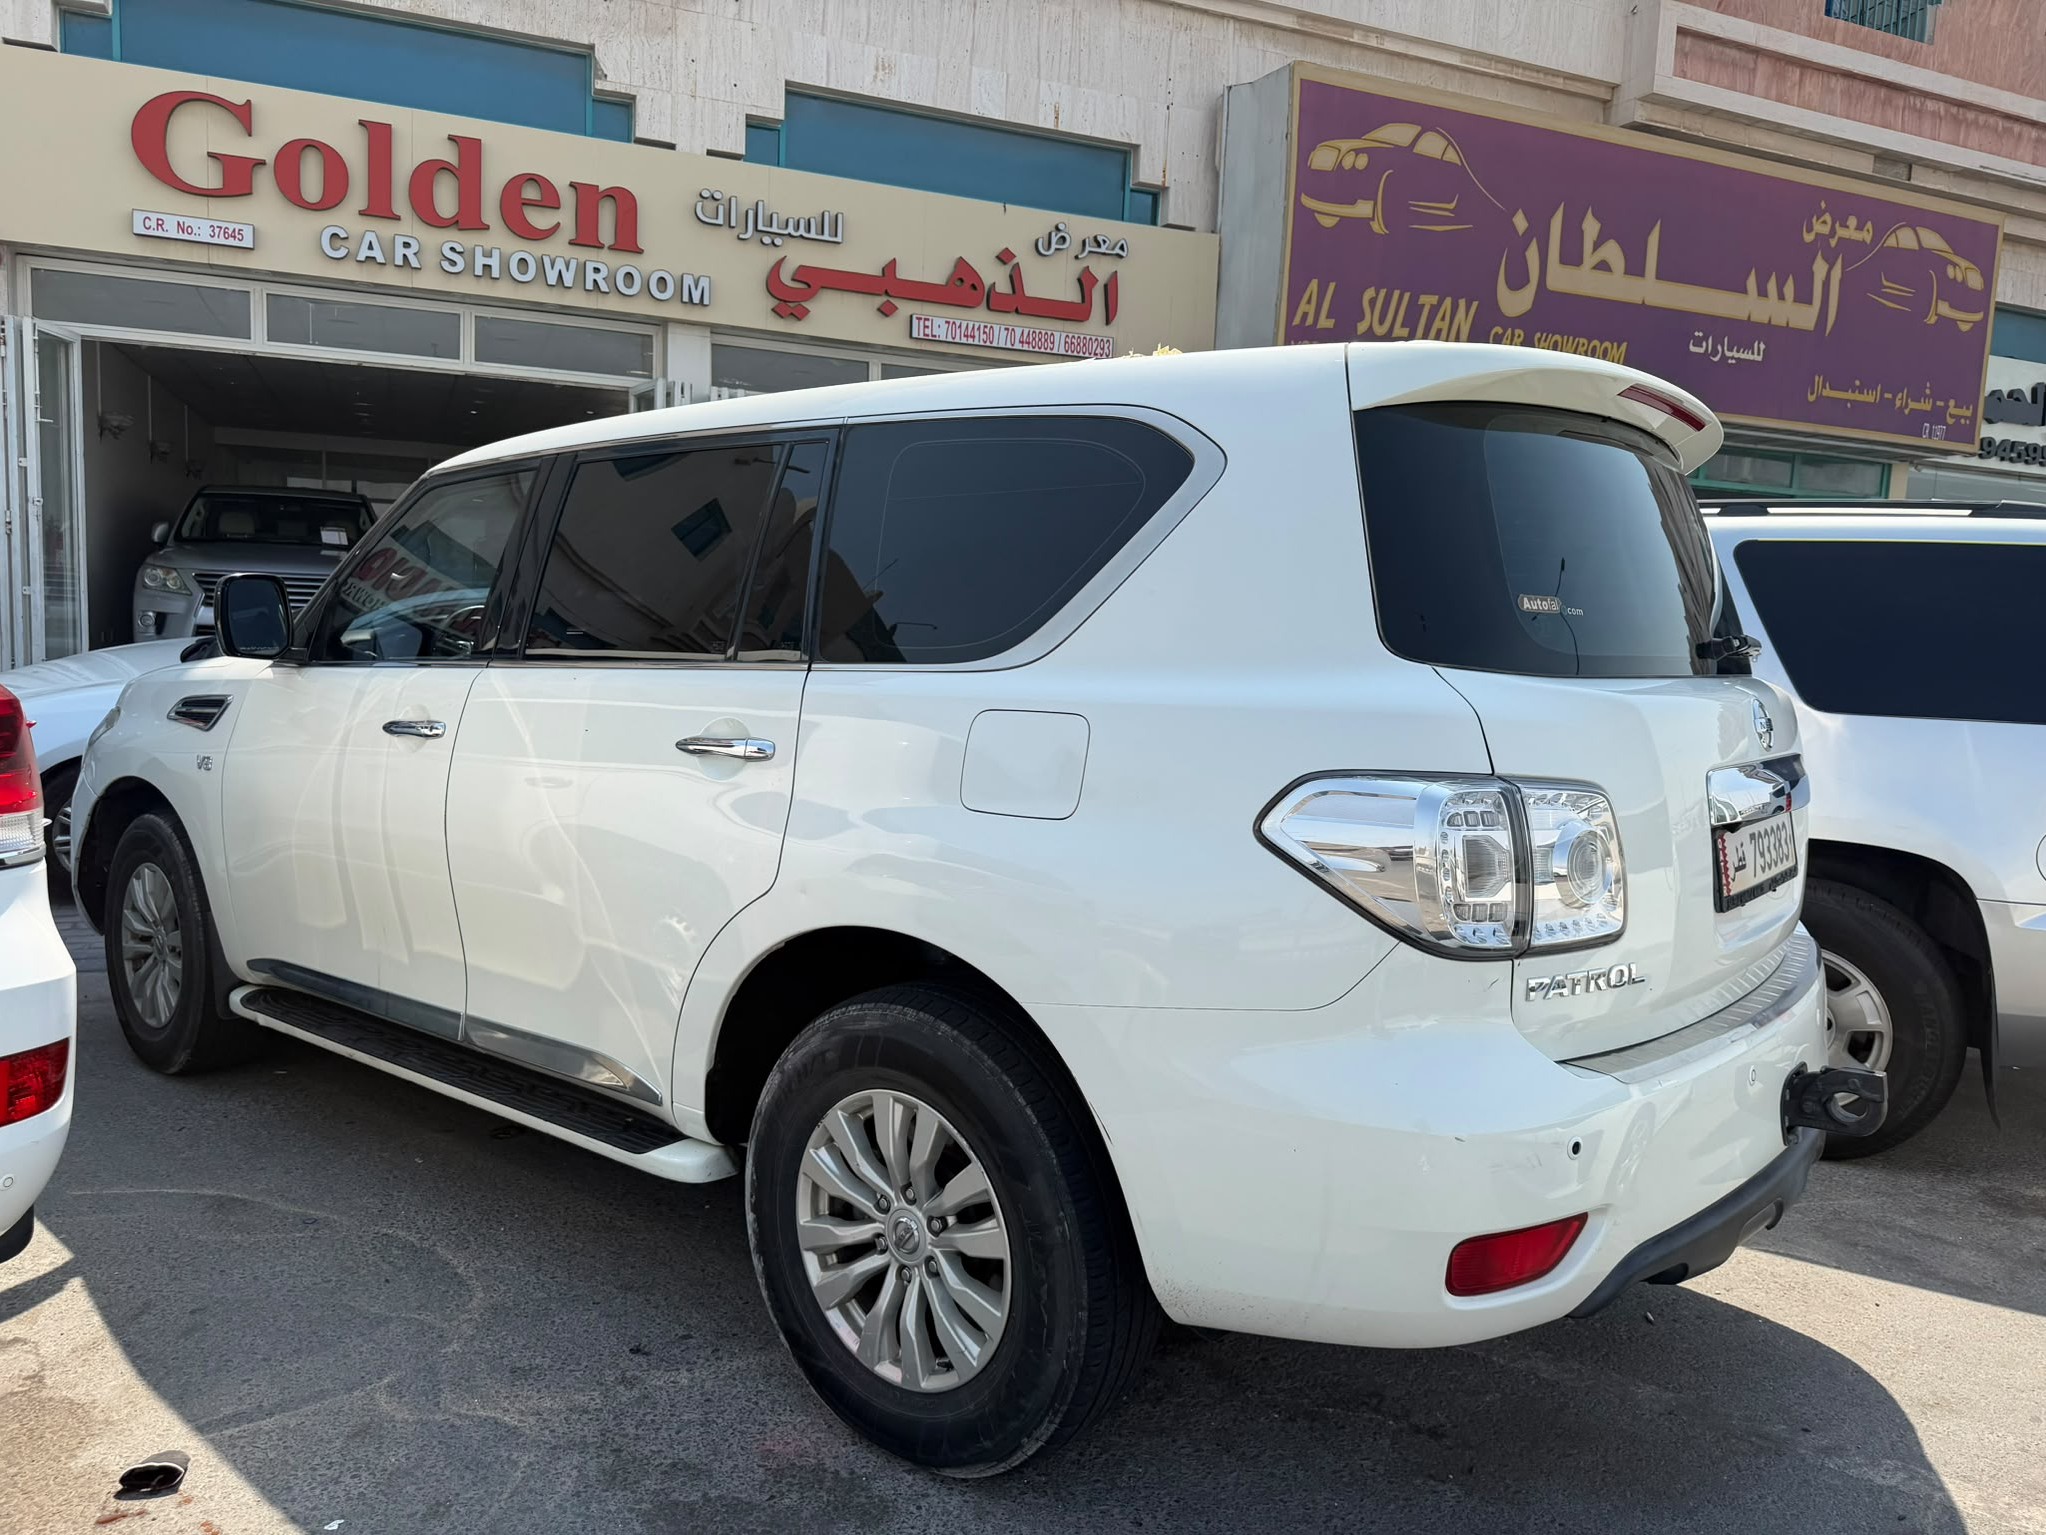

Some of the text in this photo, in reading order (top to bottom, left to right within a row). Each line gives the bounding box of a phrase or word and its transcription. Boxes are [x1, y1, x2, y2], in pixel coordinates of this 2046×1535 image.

[131, 90, 644, 254] Golden
[142, 216, 244, 242] C.R. No.: 37645
[694, 188, 844, 247] للسيارات
[1802, 200, 1873, 247] معرض
[1035, 222, 1129, 259] معرض
[320, 224, 711, 306] CAR SHOWROOM
[766, 247, 1119, 326] الذهبي
[1497, 200, 1844, 337] السلطان
[1293, 278, 1479, 342] AL SULTAN
[915, 316, 941, 338] TEL:
[944, 320, 995, 345] 70144150
[1018, 328, 1055, 352] 448889
[1064, 334, 1111, 358] 66880293
[1489, 326, 1628, 365] CAR SHOWROOM
[1688, 330, 1767, 363] للسيارات
[1895, 382, 1933, 415] شراء
[1946, 398, 1973, 425] بيع
[1749, 820, 1790, 879] 793383
[1525, 962, 1646, 1002] PATROL
